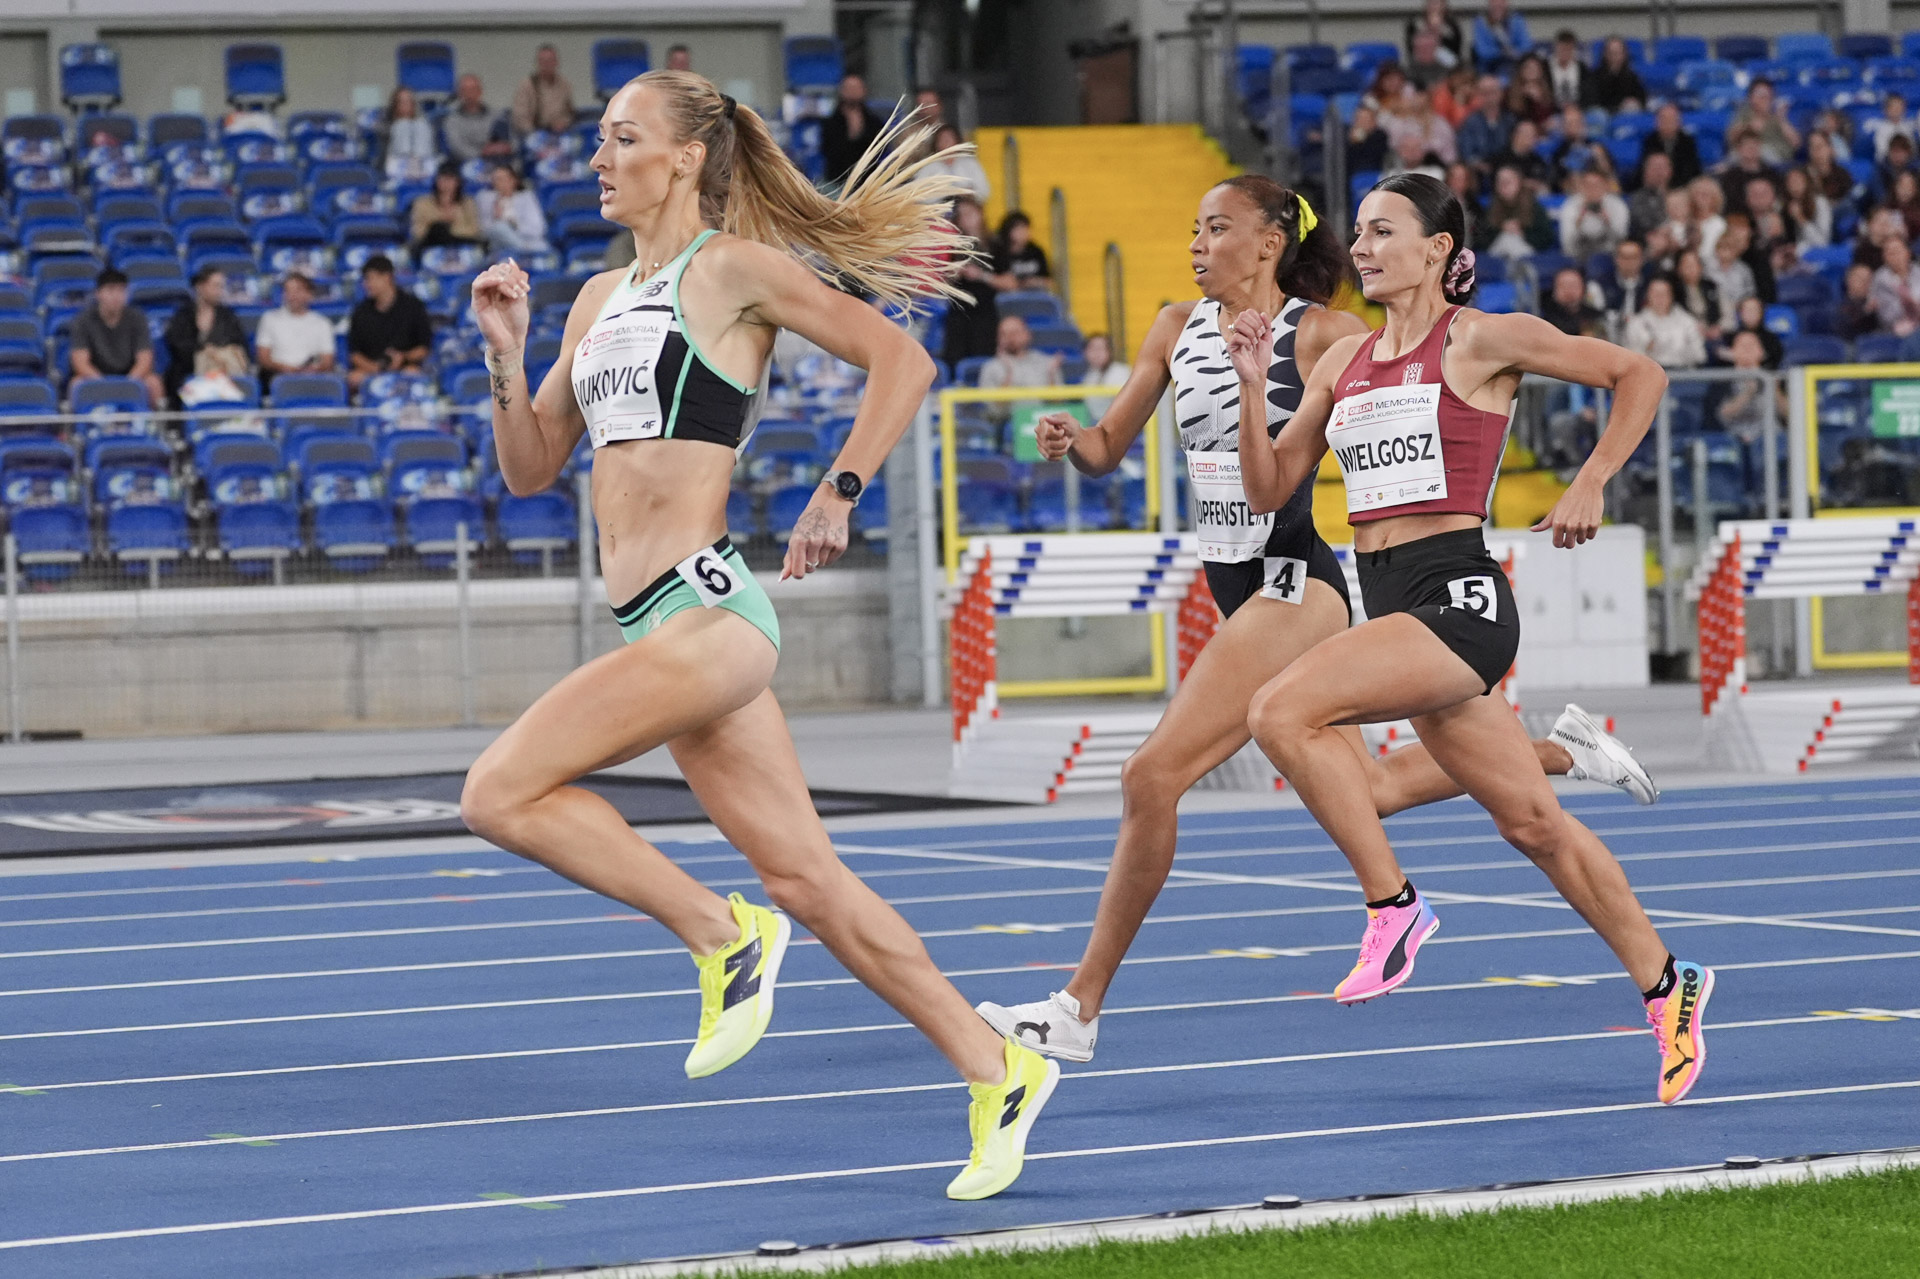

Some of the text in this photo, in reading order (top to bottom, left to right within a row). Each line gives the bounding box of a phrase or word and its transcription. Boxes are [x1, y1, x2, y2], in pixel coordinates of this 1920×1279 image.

[575, 359, 649, 410] VUKOVIĆ
[1348, 396, 1433, 416] ORLEN MEMORIAŁ
[1335, 433, 1436, 474] WIELGOSZ
[694, 555, 732, 596] 6
[1271, 562, 1296, 599] 4
[1463, 580, 1490, 617] 5
[1674, 967, 1699, 1041] NITRO
